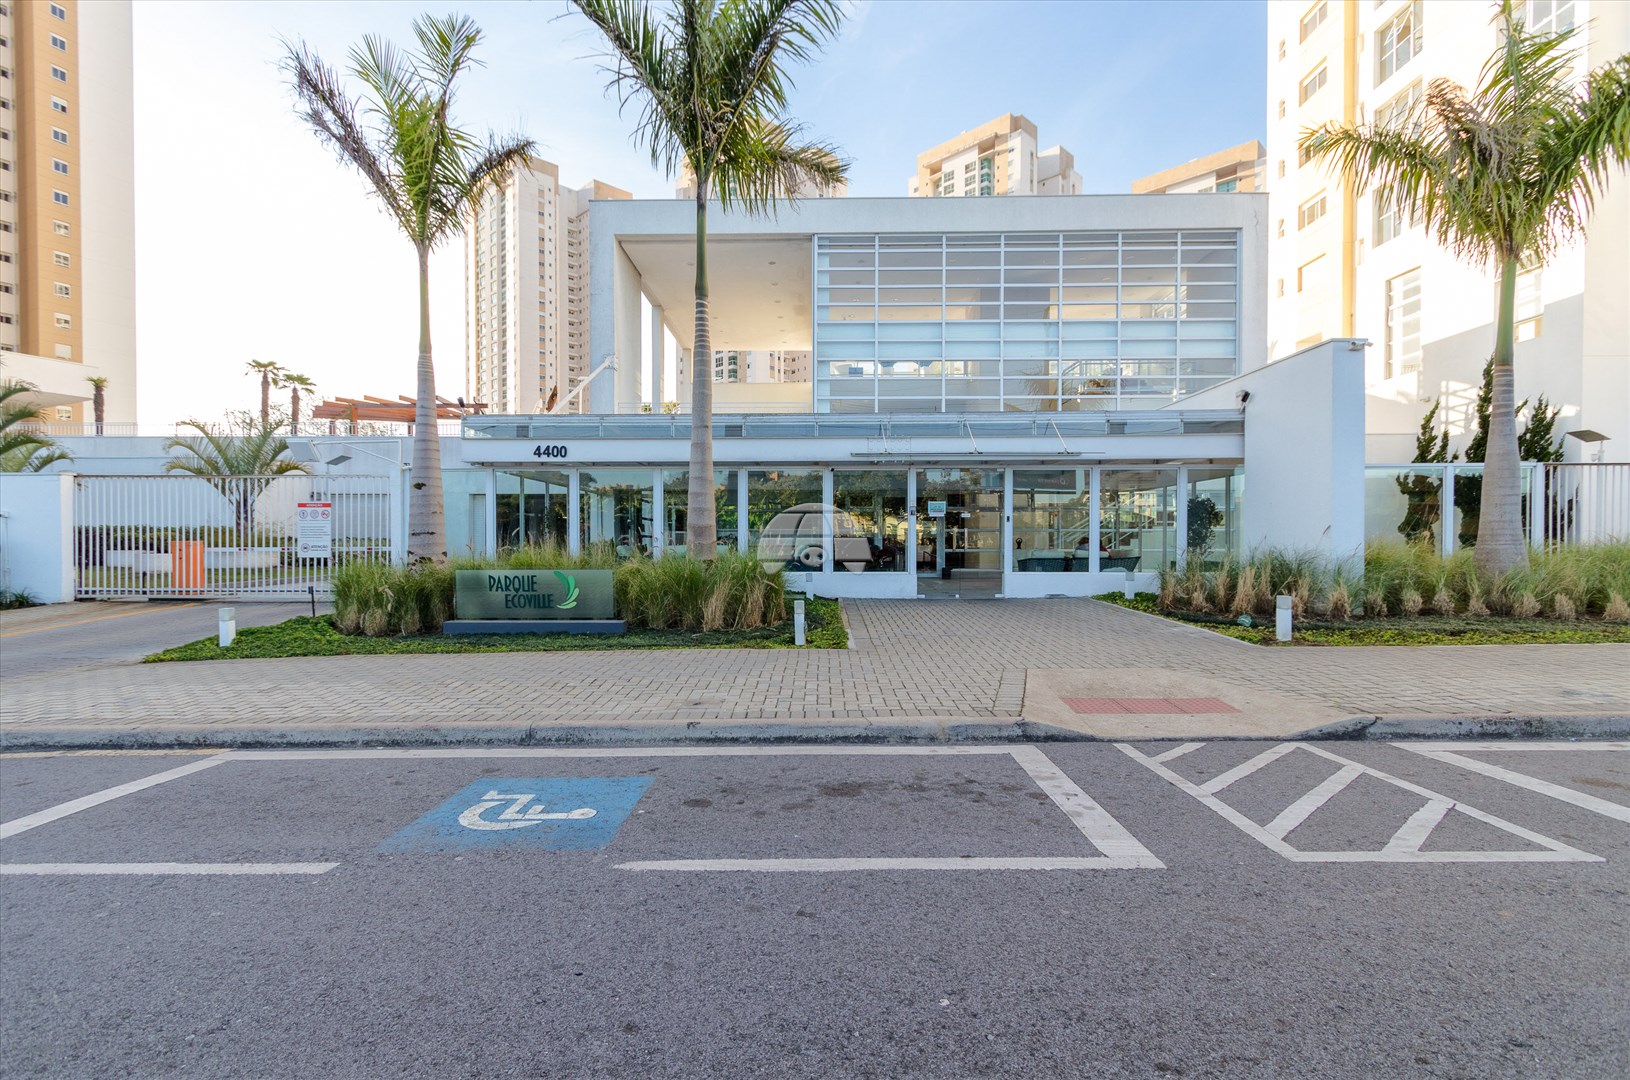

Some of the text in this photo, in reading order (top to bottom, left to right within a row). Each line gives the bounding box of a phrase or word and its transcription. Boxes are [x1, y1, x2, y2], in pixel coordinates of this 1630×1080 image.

[533, 445, 567, 458] 4400
[488, 574, 537, 594] PARQUE
[505, 594, 554, 609] ECOVILLE
